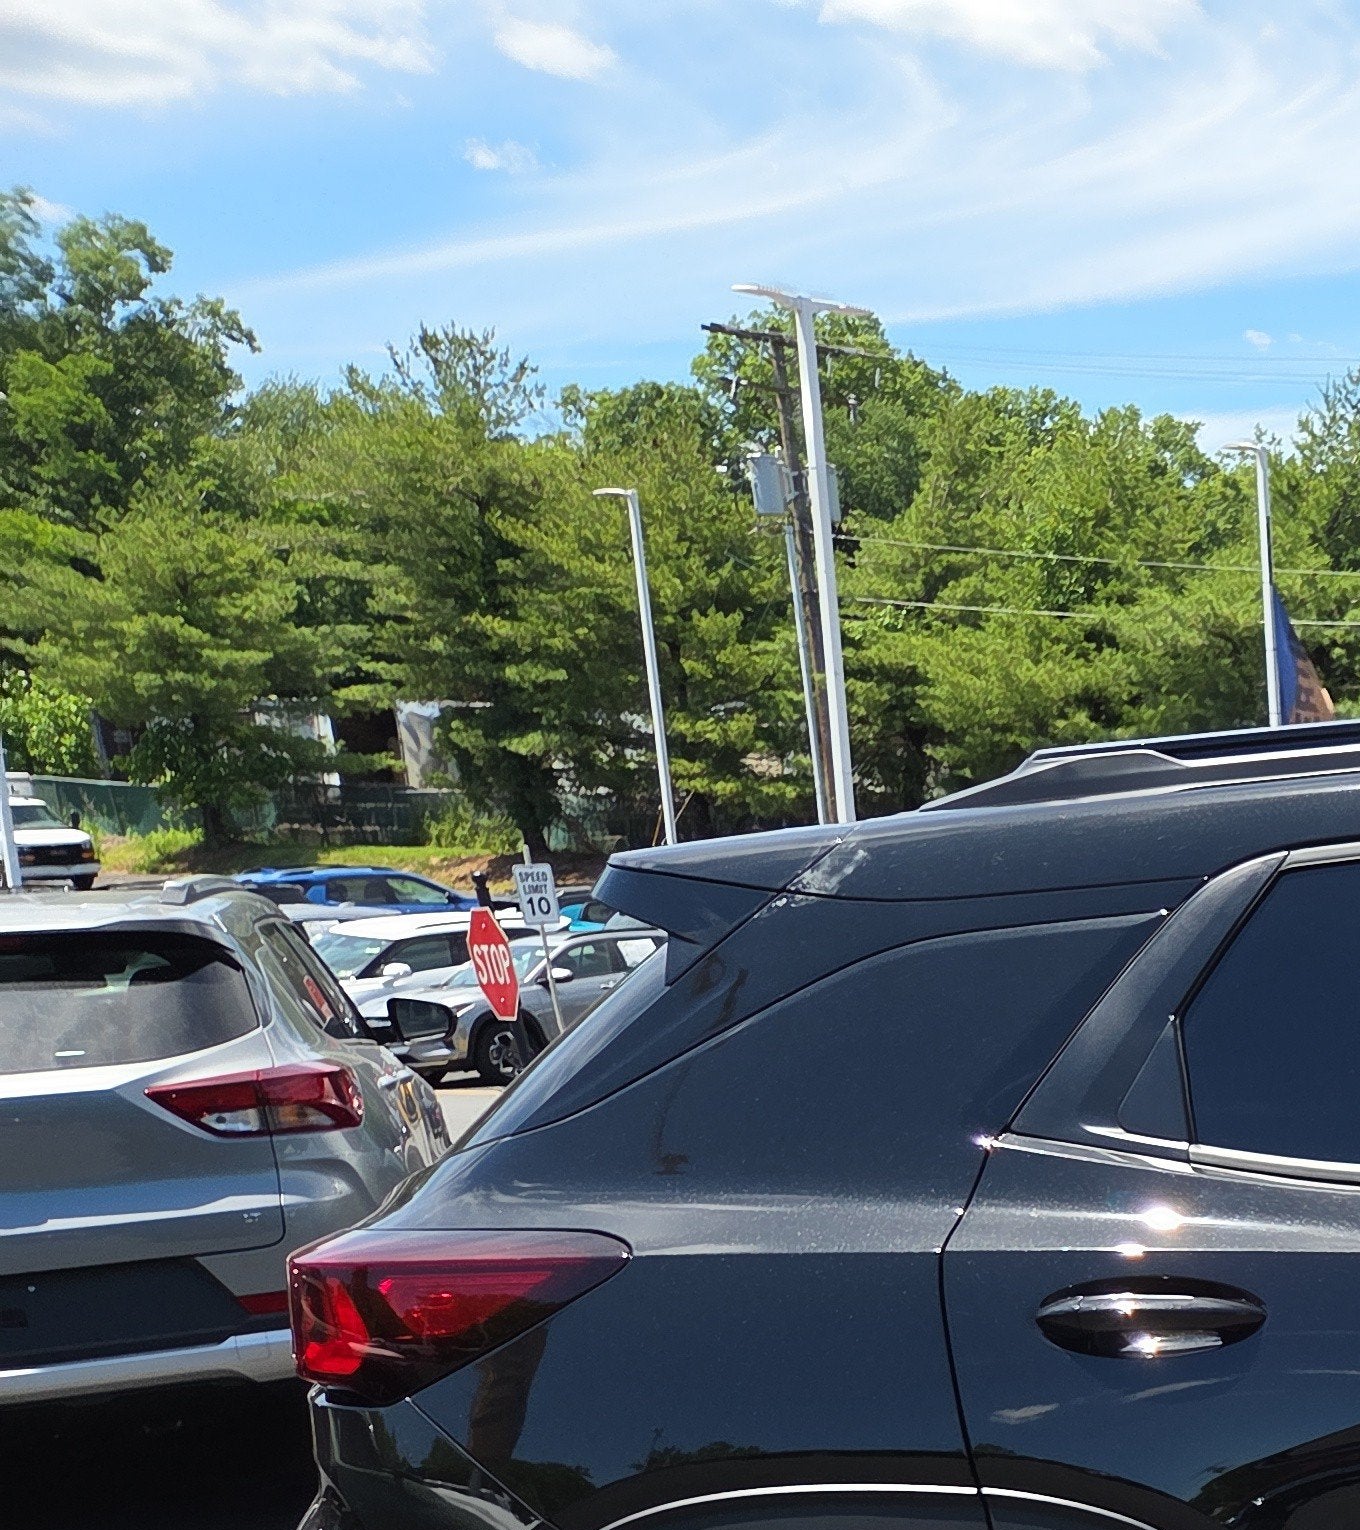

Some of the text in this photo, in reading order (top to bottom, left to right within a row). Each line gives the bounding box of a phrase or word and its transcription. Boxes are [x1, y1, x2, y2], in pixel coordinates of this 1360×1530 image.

[518, 871, 548, 883] SPEED
[522, 884, 547, 895] LIMIT
[527, 896, 551, 917] 10
[472, 943, 511, 985] STOP
